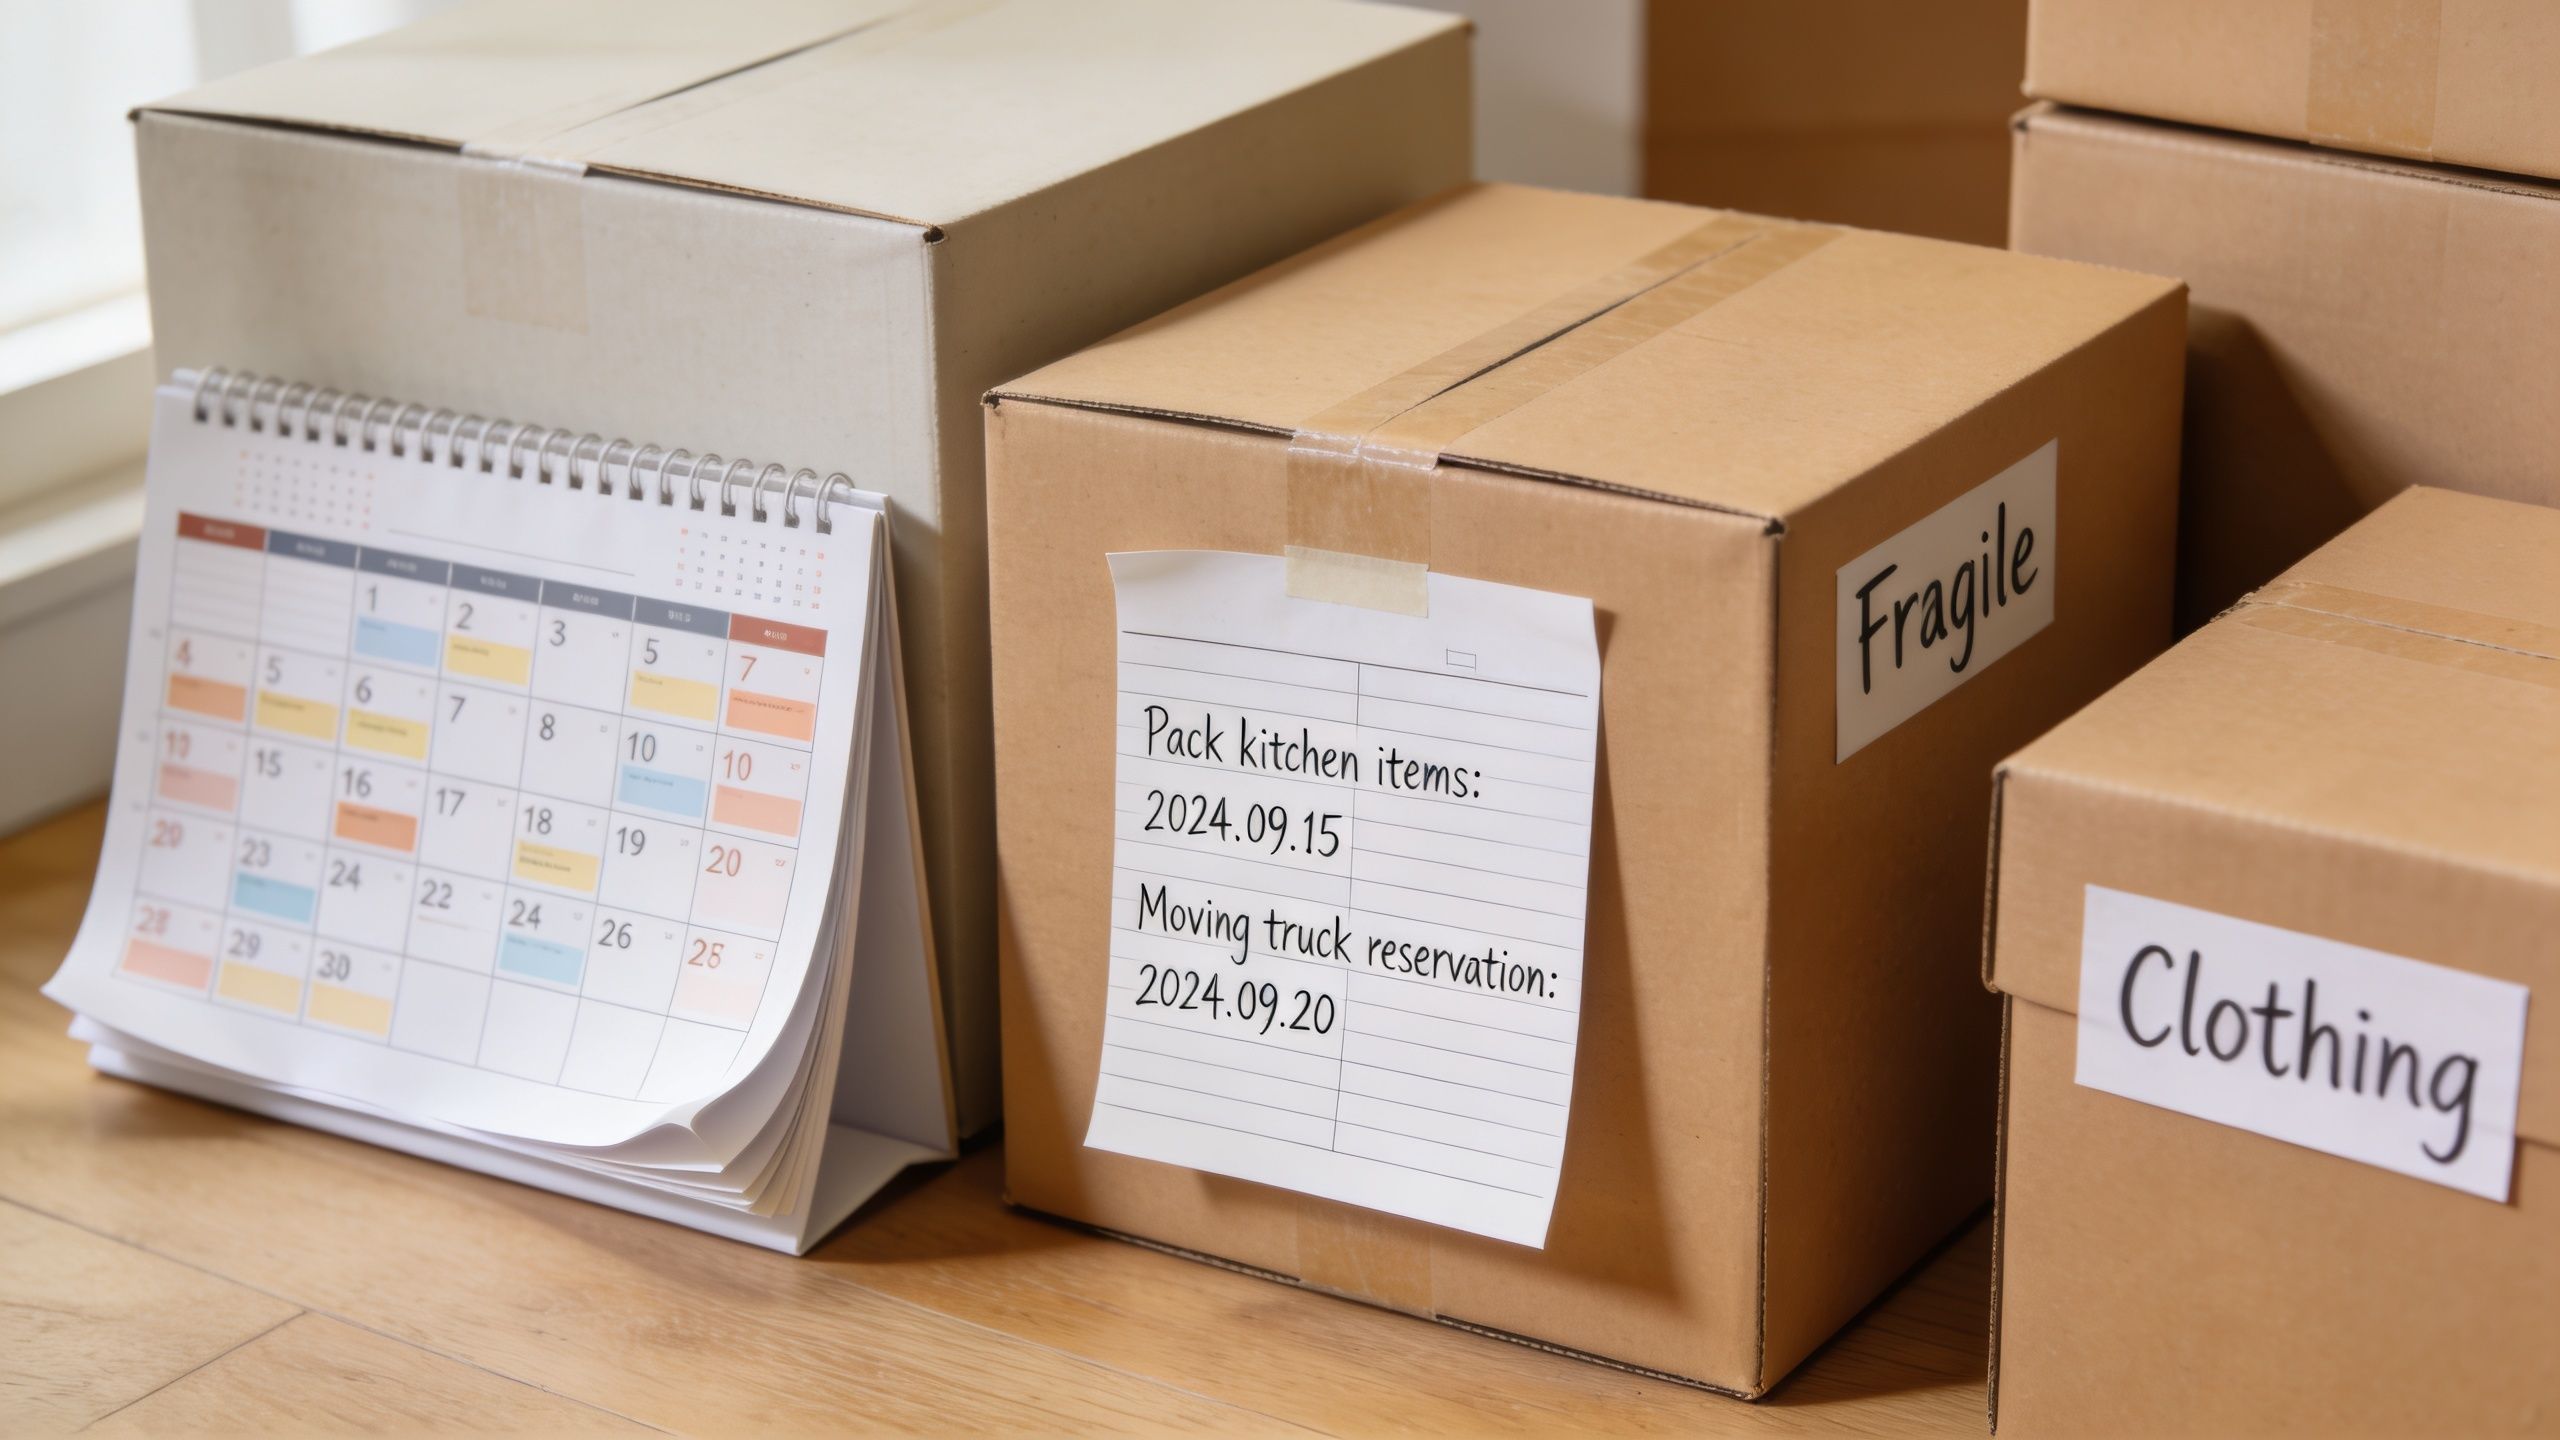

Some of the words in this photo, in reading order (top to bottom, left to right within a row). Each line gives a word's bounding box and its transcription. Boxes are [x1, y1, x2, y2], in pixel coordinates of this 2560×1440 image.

[367, 585, 378, 611] 1
[1855, 502, 2039, 695] Fragile
[455, 602, 474, 631] 2
[549, 619, 566, 647] 3
[643, 637, 660, 665] 5
[265, 654, 282, 685] 5
[740, 655, 758, 682] 7
[354, 676, 373, 704] 6
[450, 695, 467, 723] 7
[539, 713, 556, 742] 8
[255, 748, 282, 778] 15
[627, 731, 657, 763] 10
[1144, 706, 1223, 762] Pack
[1241, 717, 1358, 782] kitchen
[1379, 747, 1480, 798] items:
[723, 749, 753, 782] 10
[341, 767, 372, 799] 16
[436, 787, 467, 817] 17
[525, 806, 553, 836] 18
[1145, 790, 1342, 858] 2024.09.15
[617, 826, 646, 857] 19
[329, 859, 362, 892] 24
[705, 844, 742, 877] 20
[419, 879, 453, 910] 22
[507, 899, 543, 931] 24
[227, 928, 262, 960] 29
[597, 918, 633, 950] 26
[1139, 883, 1250, 966] Moving
[1264, 909, 1351, 962] truck
[1369, 937, 1557, 998] reservation:
[316, 950, 351, 982] 30
[1136, 963, 1336, 1035] 2024.09.20
[2120, 944, 2479, 1165] Clothing
